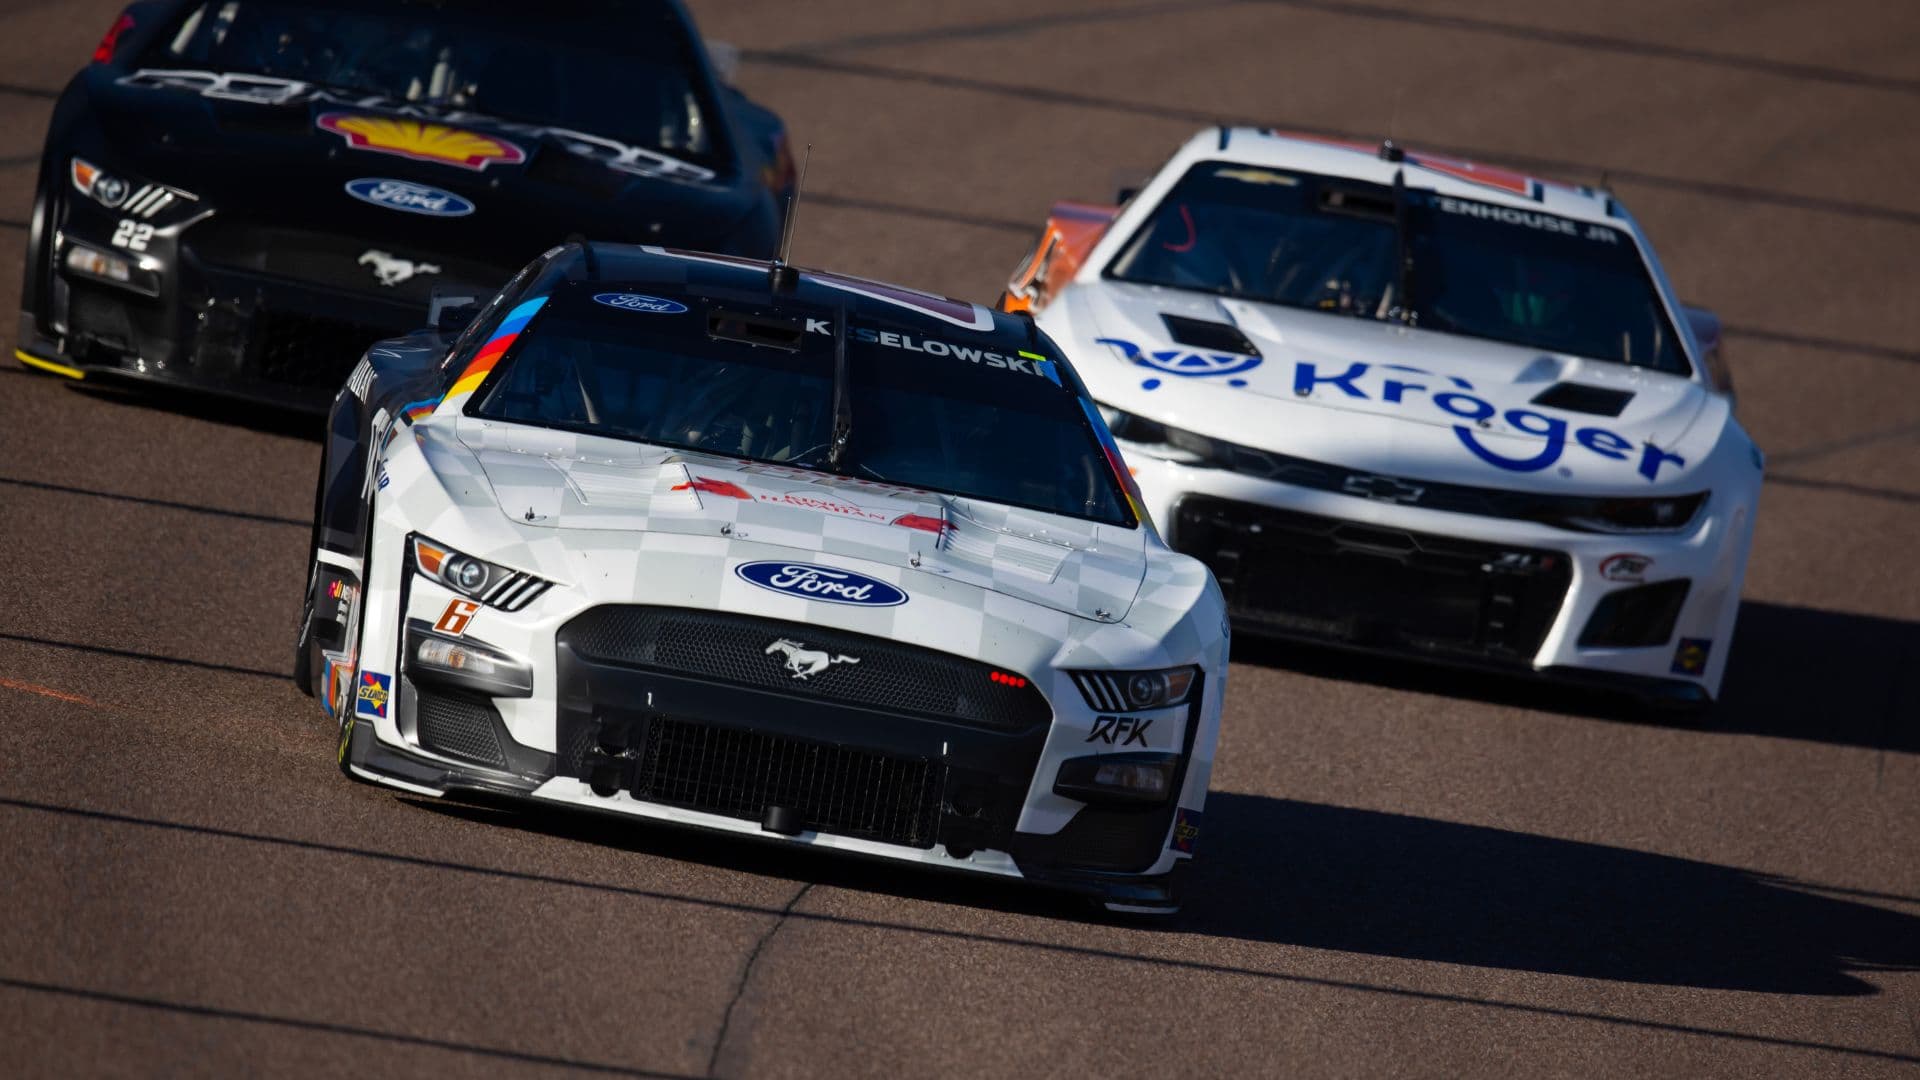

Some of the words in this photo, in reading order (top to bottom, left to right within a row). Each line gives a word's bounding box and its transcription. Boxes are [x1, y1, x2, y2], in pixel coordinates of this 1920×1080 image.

[369, 181, 449, 211] Ford
[111, 219, 154, 251] 22
[611, 295, 671, 311] Ford
[805, 318, 1044, 377] KSELOWSKI
[1293, 362, 1685, 482] Kroger
[770, 565, 874, 600] Ford
[432, 598, 481, 637] 6
[1084, 715, 1154, 748] RFK
